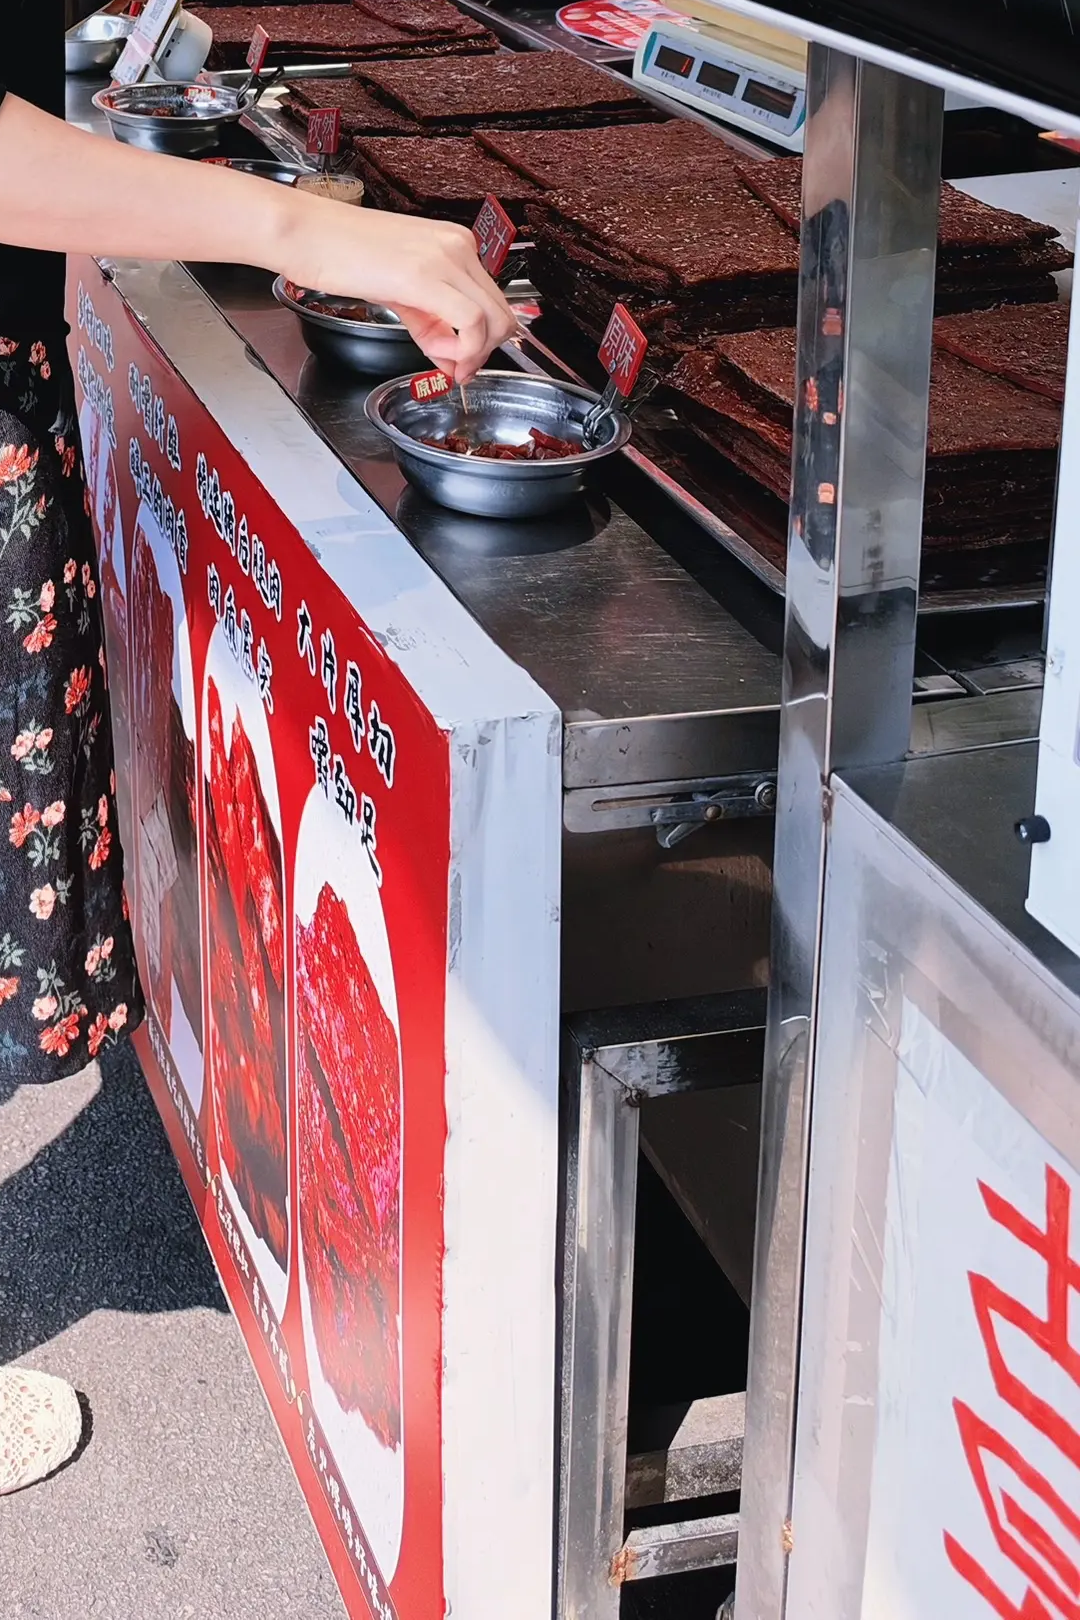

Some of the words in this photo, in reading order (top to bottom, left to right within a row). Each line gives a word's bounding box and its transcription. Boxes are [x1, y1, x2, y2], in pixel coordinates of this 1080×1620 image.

[414, 371, 449, 400] 原味
[598, 311, 638, 378] 原味
[195, 451, 284, 623] 精选猪后腿肉
[296, 598, 397, 790] 大片厚切
